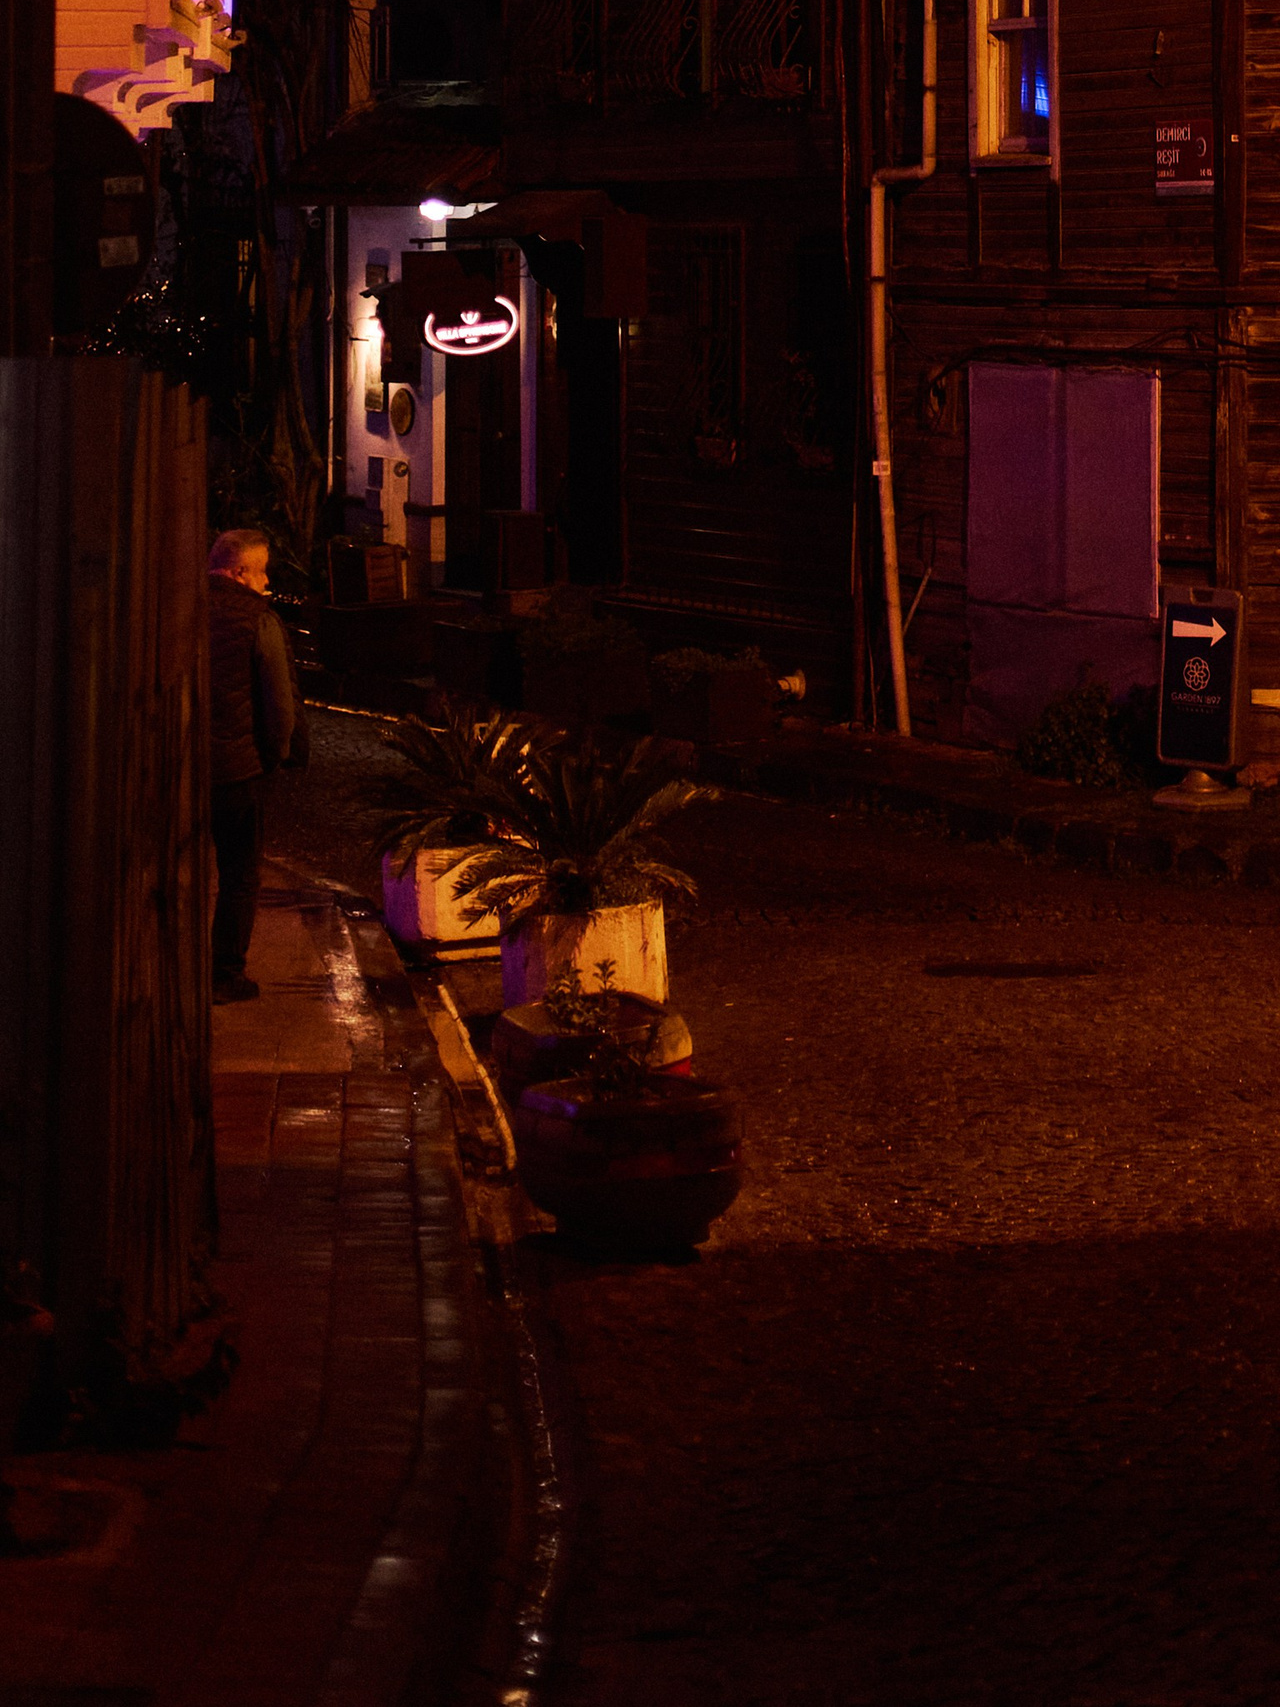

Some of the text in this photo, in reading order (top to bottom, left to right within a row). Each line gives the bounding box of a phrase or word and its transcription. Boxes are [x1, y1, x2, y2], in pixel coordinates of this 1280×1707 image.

[1156, 123, 1191, 142] DEMİRCİ
[1156, 146, 1180, 167] REŞİT
[1170, 691, 1203, 703] GARDEN
